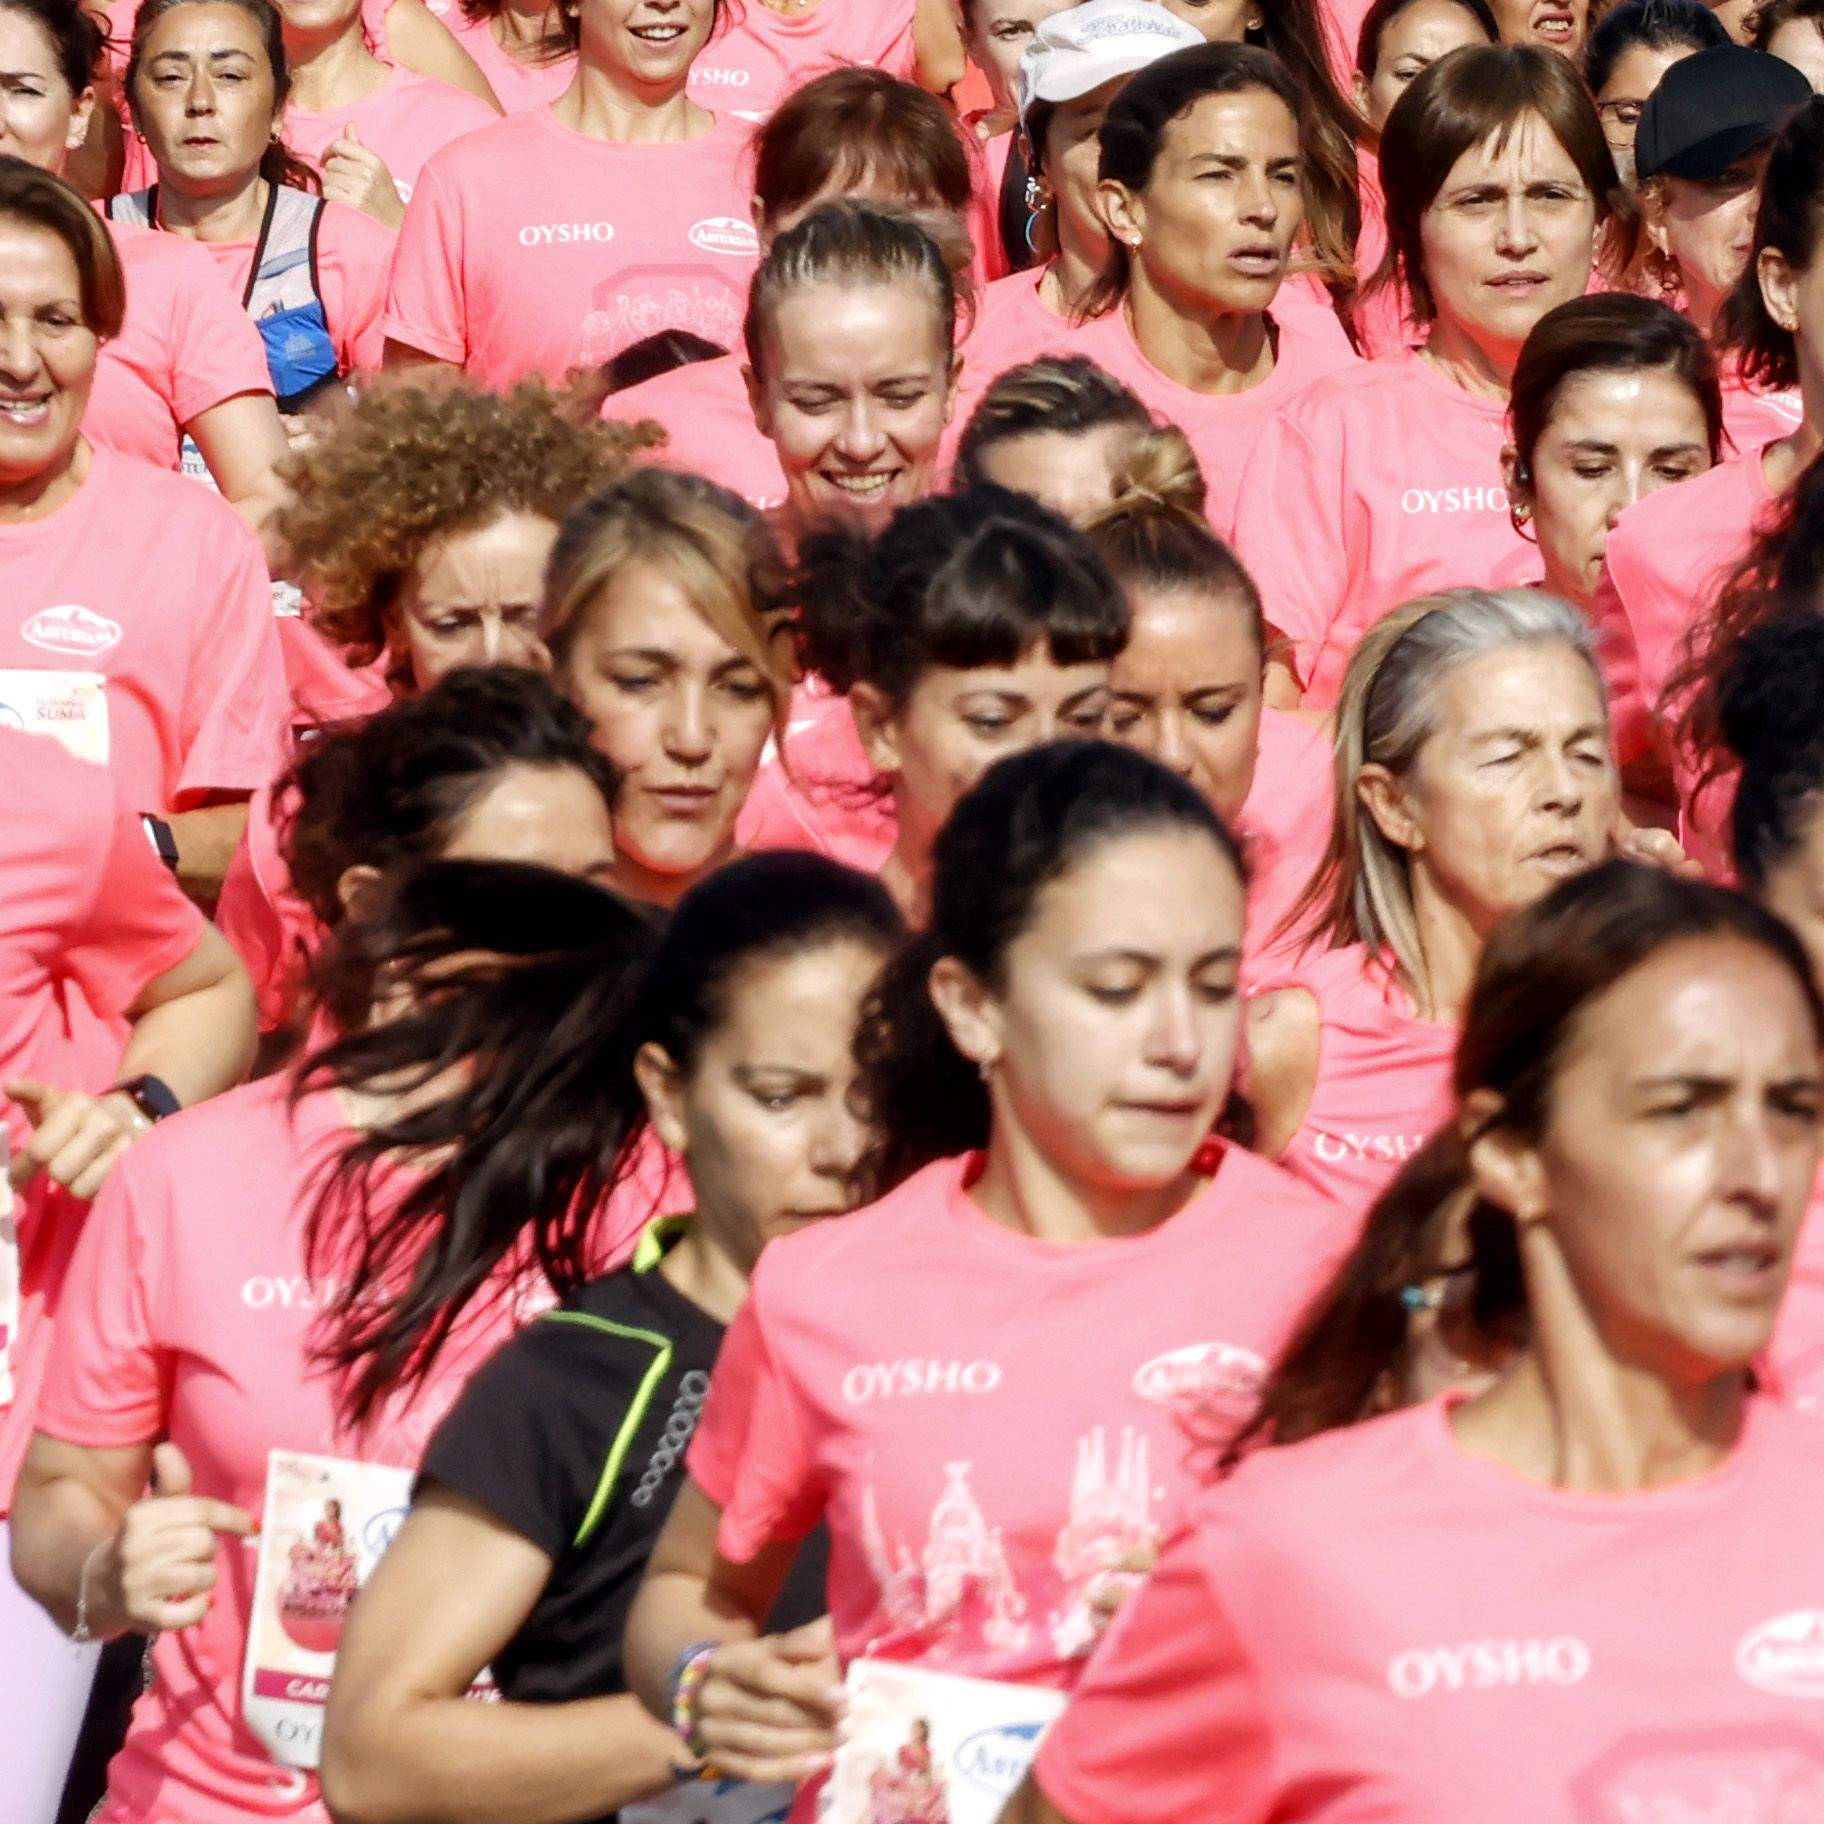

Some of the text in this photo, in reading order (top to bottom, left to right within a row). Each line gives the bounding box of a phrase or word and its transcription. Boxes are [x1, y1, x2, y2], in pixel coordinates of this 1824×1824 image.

[689, 68, 750, 87] YSHO
[519, 221, 615, 247] OYSHO
[1402, 487, 1509, 515] OYSHO
[841, 1358, 1002, 1405] OYSHO
[1388, 1635, 1592, 1700] OYSHO
